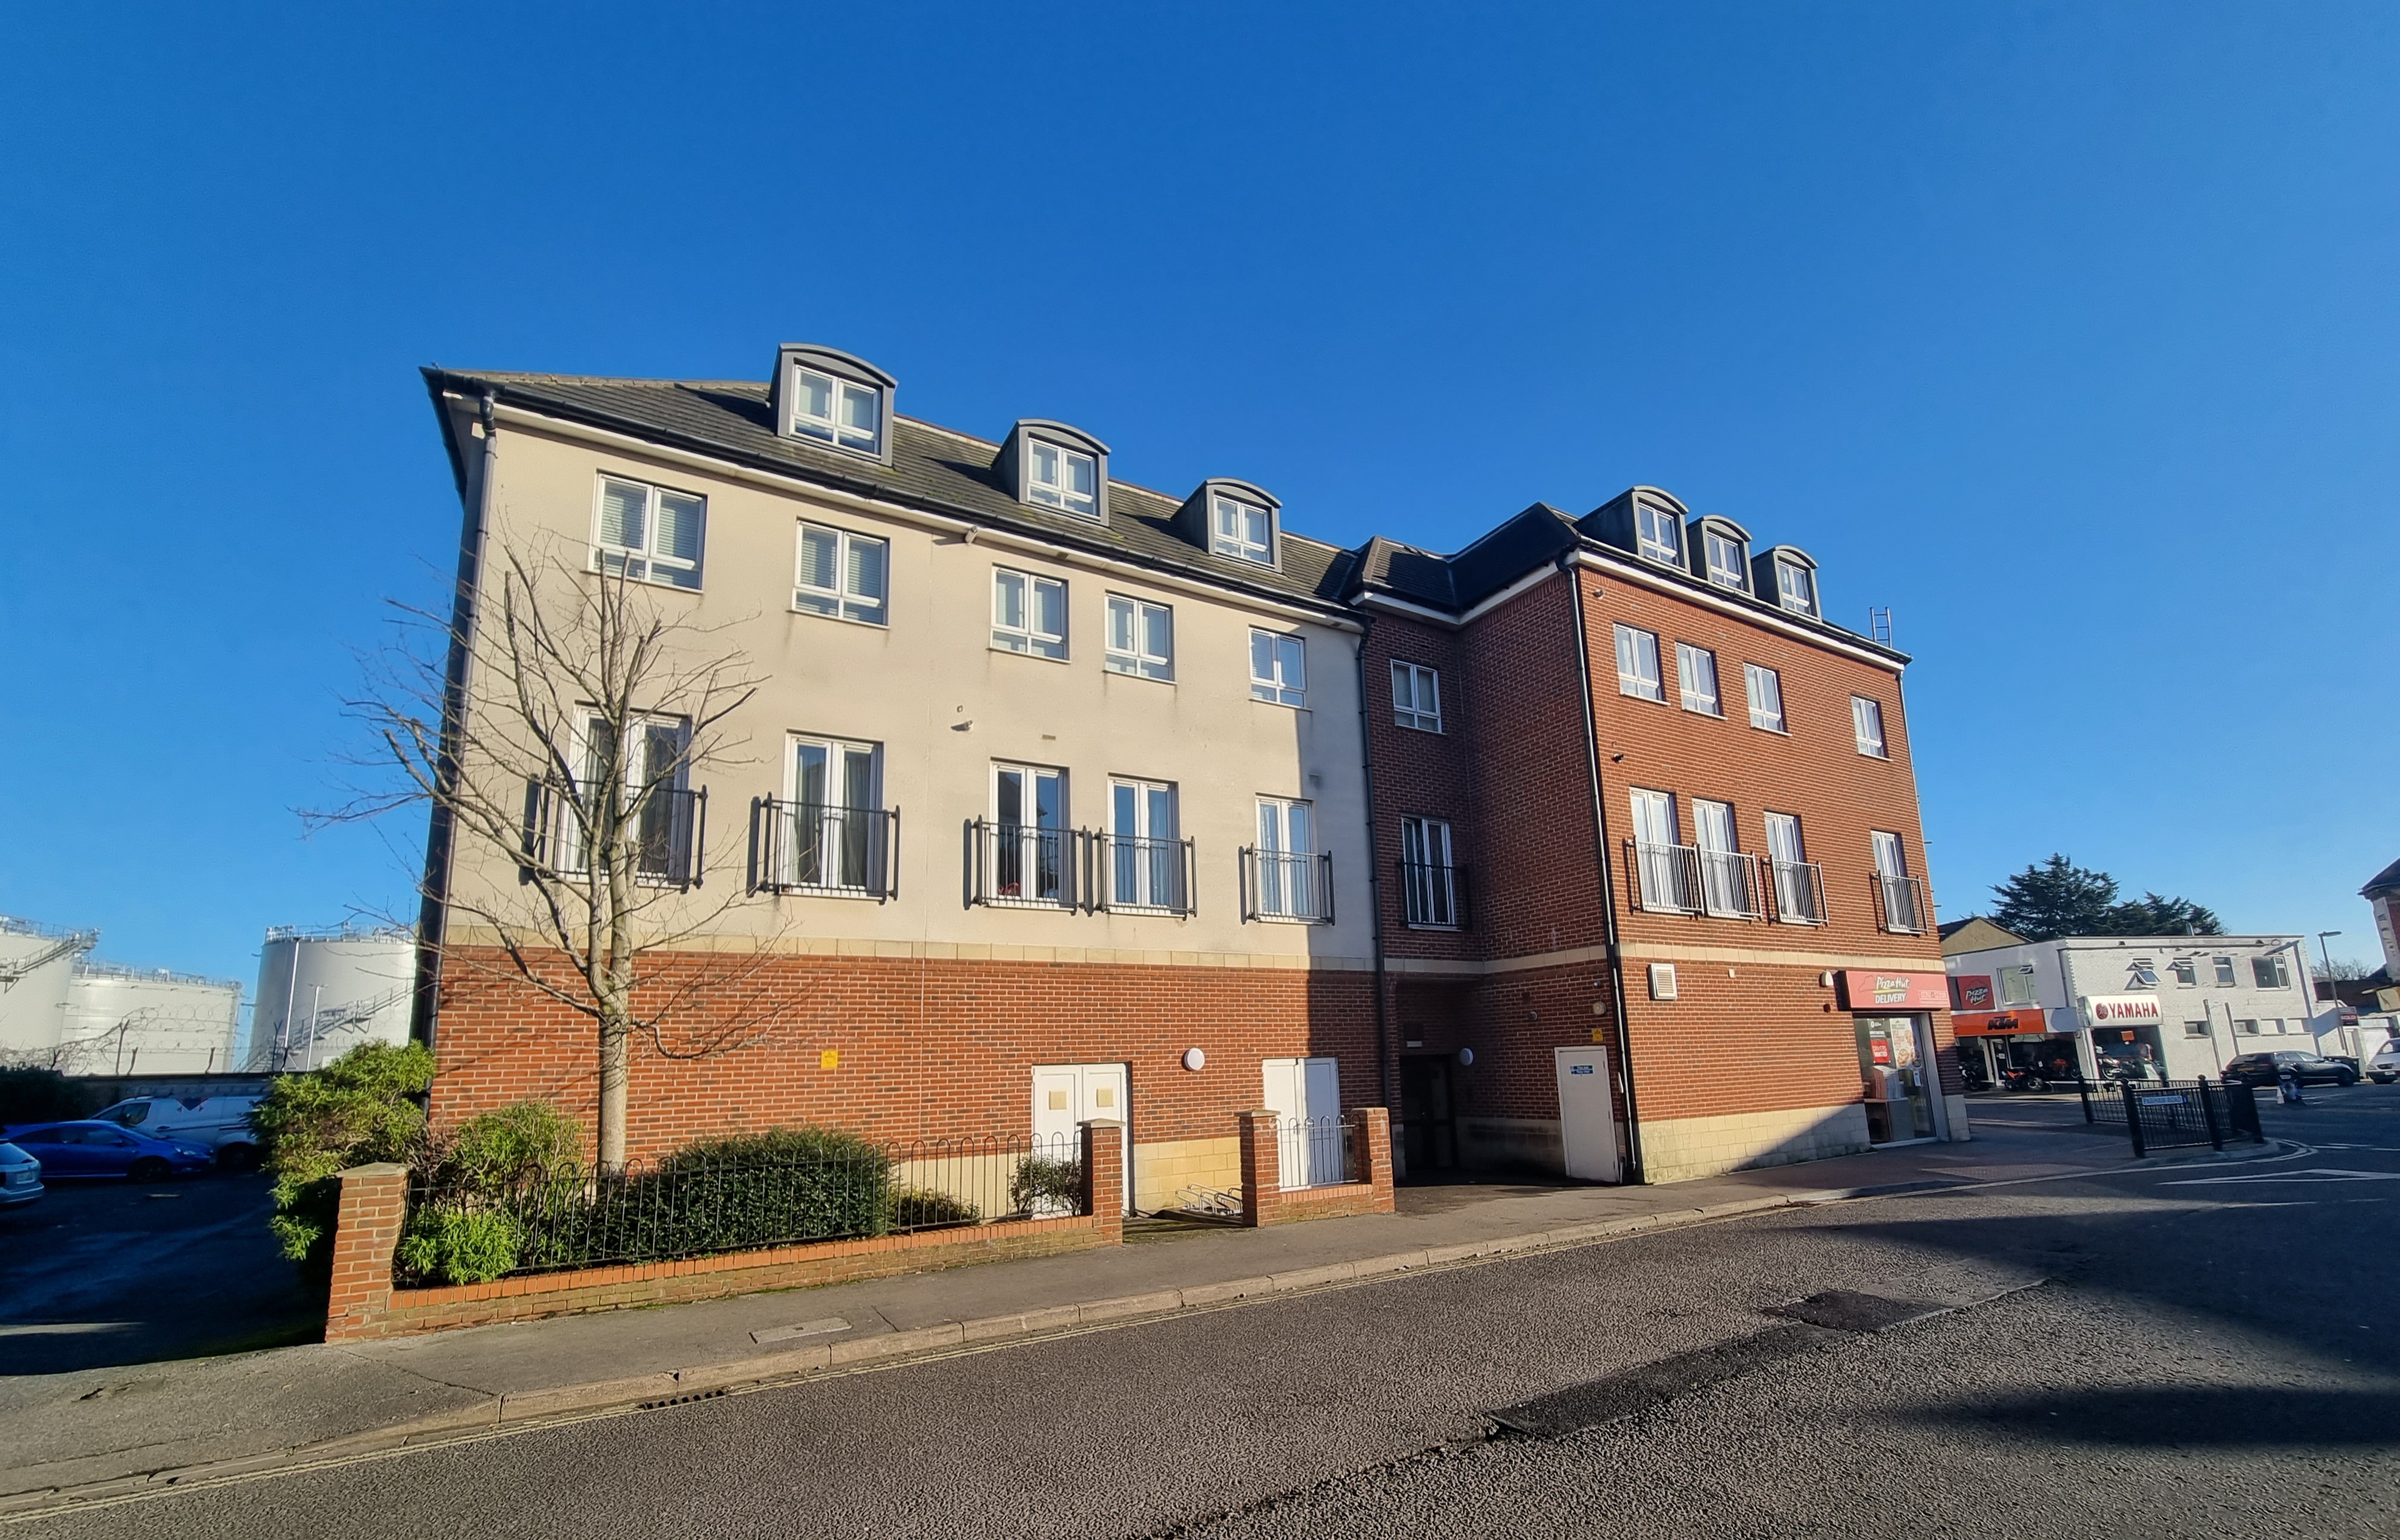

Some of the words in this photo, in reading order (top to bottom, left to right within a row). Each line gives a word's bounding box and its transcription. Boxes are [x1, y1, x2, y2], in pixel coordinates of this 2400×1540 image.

[1876, 976, 1895, 990] Pizza
[1895, 976, 1910, 989] Hut
[1875, 993, 1907, 1004] DELIVERY
[1966, 988, 1988, 1001] Pizza
[1970, 995, 1986, 1004] Hut
[2108, 1002, 2159, 1019] YAMAHA
[1988, 1016, 2019, 1030] KTM
